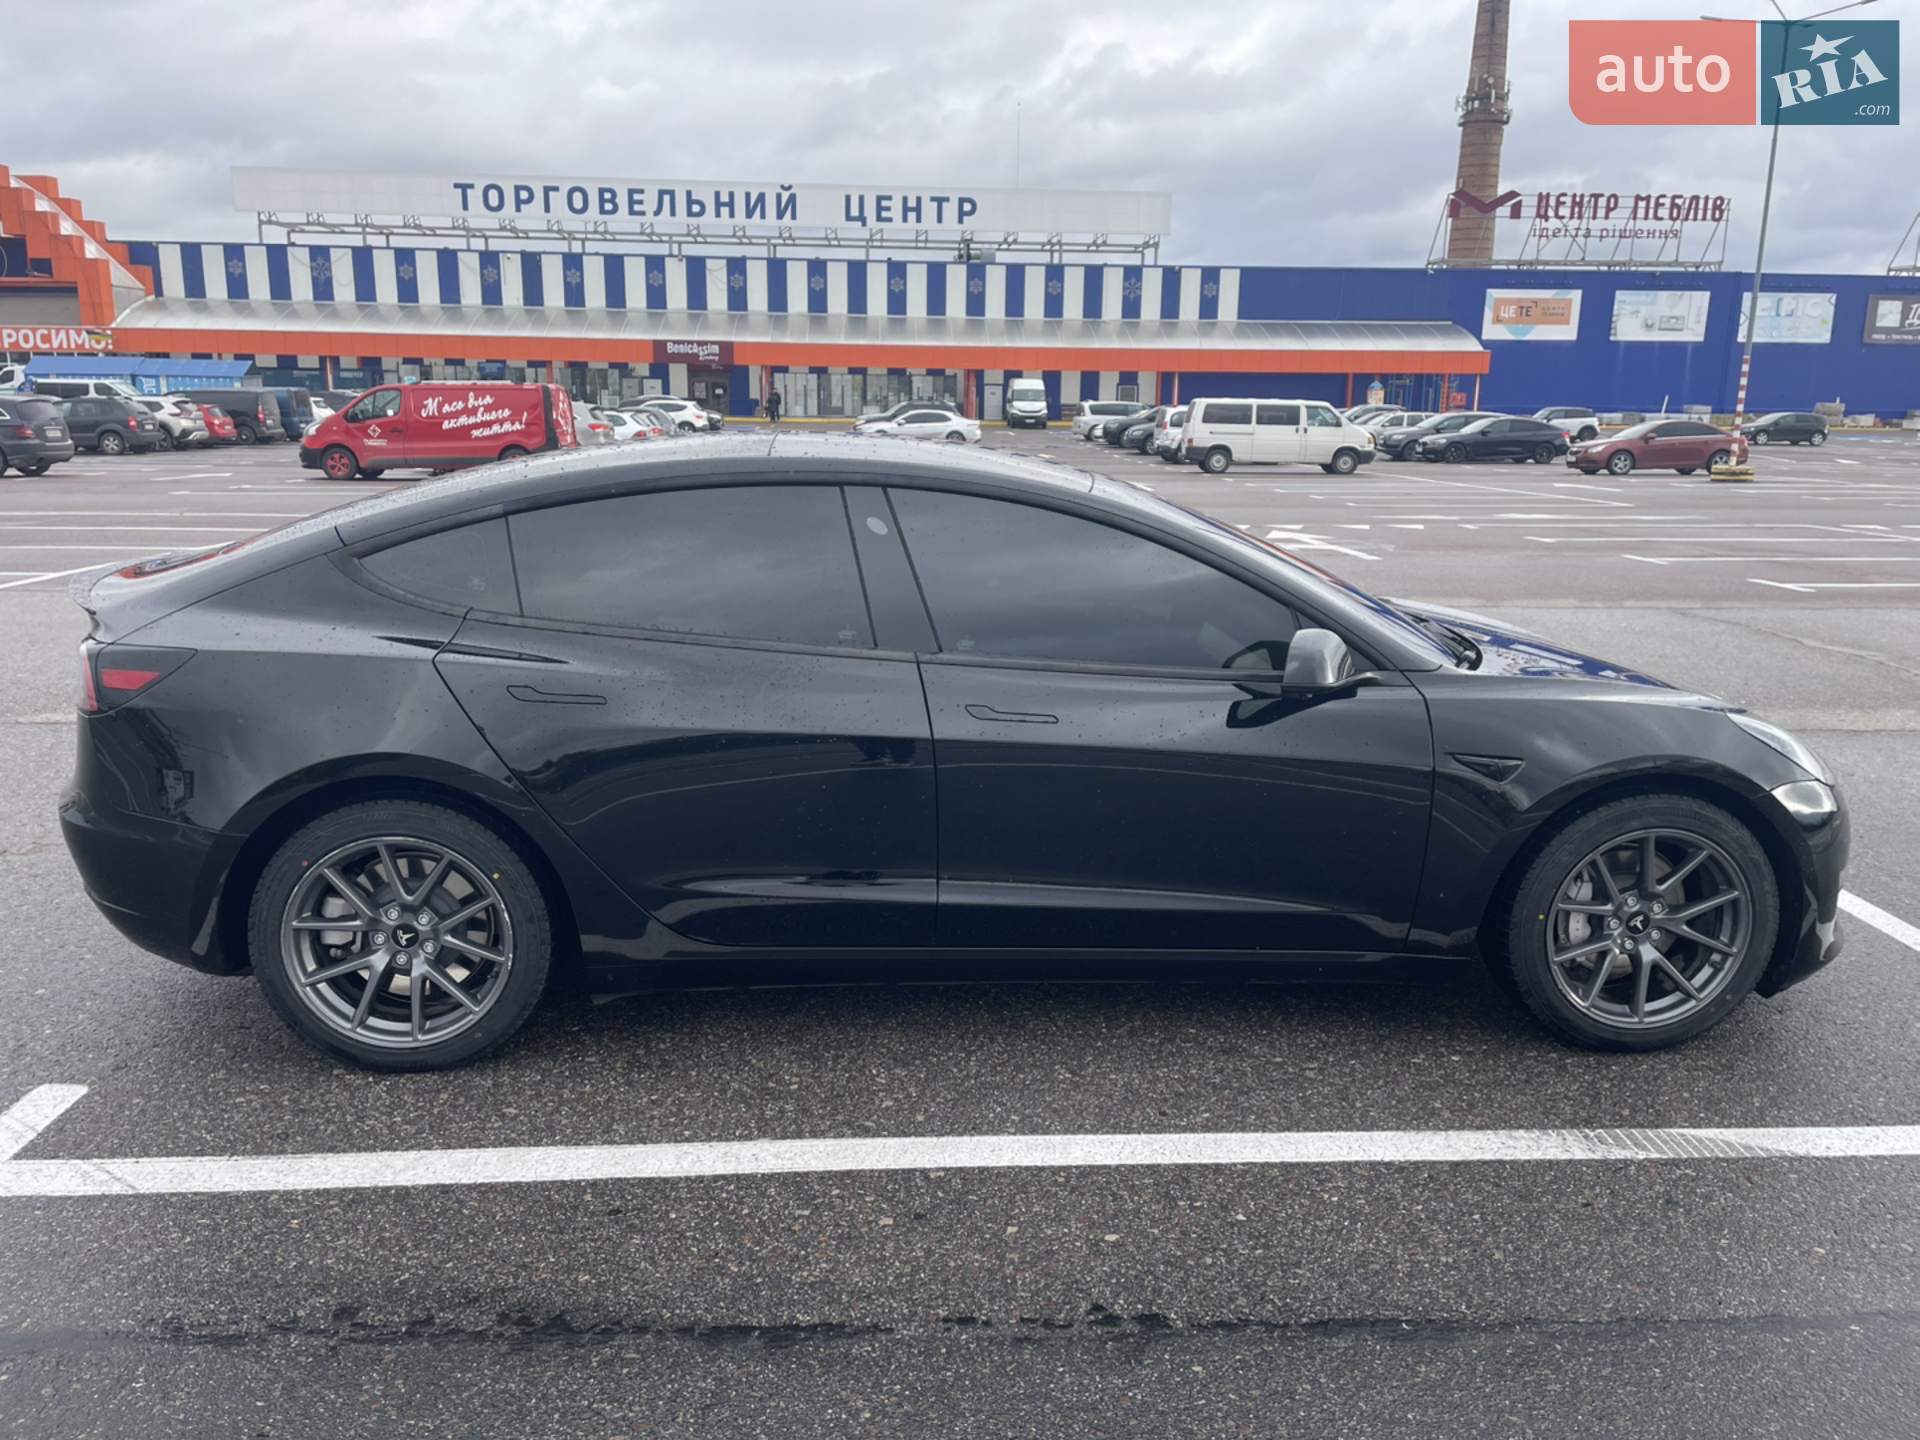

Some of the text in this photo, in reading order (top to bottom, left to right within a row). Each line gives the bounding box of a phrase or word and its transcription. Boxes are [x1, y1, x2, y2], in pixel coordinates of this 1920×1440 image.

[453, 182, 978, 227] ТОРГОВЕЛЬНИЙ ЦЕНТР
[1535, 191, 1727, 222] ЦЕНТР МЕБЛІВ
[1599, 224, 1681, 243] рішення
[0, 328, 114, 350] РОСИМО!
[421, 391, 496, 418] М'ясо для
[442, 406, 513, 430] активного
[470, 411, 528, 440] життя!
